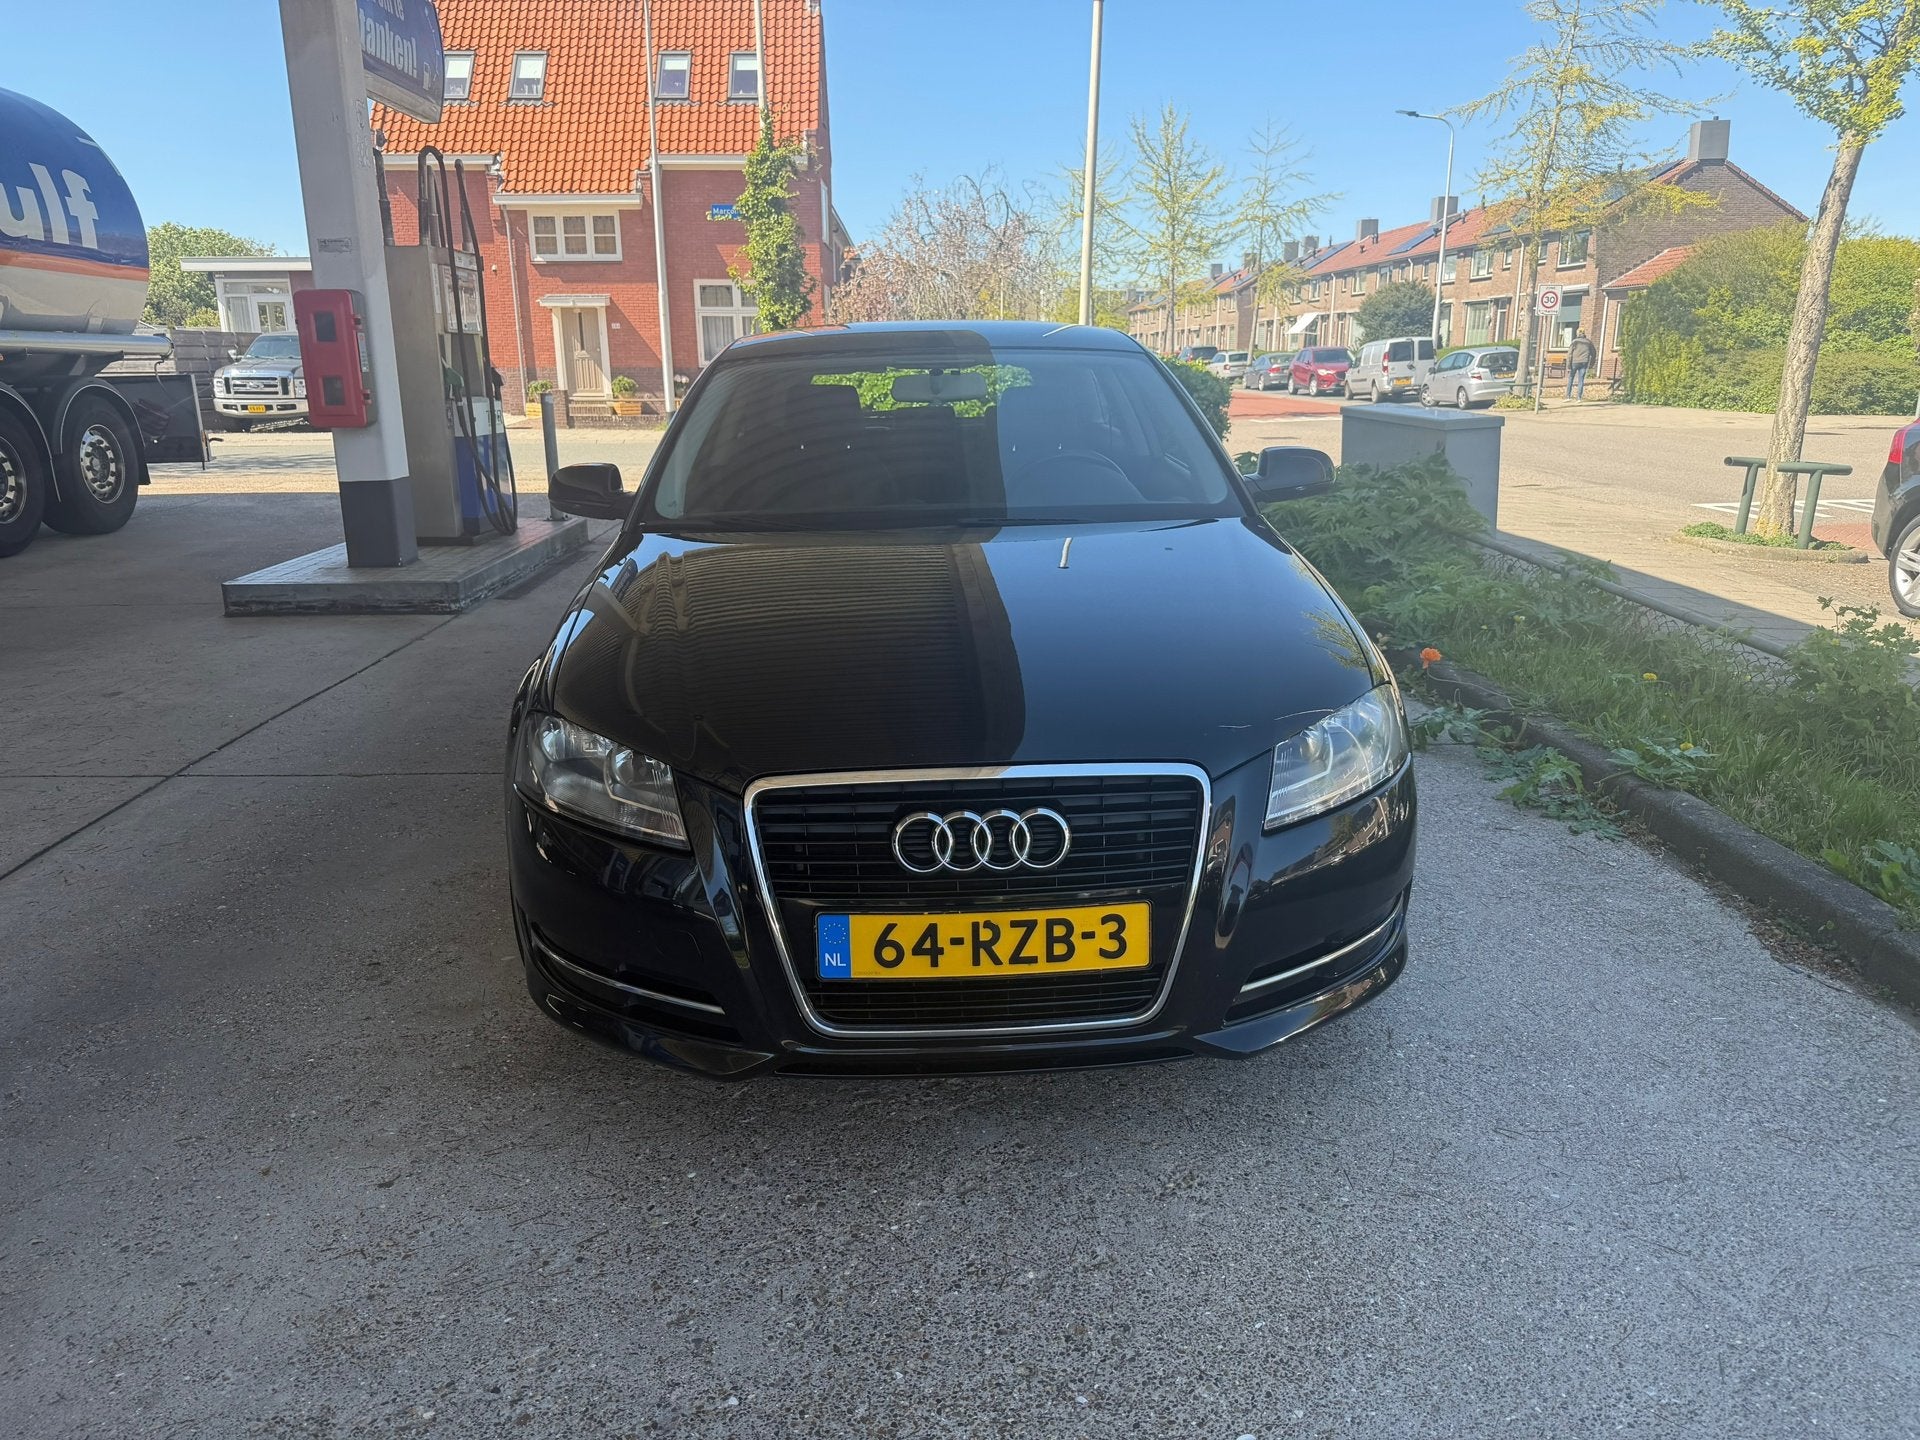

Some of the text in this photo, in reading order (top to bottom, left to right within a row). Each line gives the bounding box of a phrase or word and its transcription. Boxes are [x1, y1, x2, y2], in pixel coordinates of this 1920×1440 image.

[359, 8, 417, 78] tanken!
[1543, 296, 1556, 304] 30
[873, 913, 1127, 968] 64-RZB-3
[825, 953, 846, 967] NL
